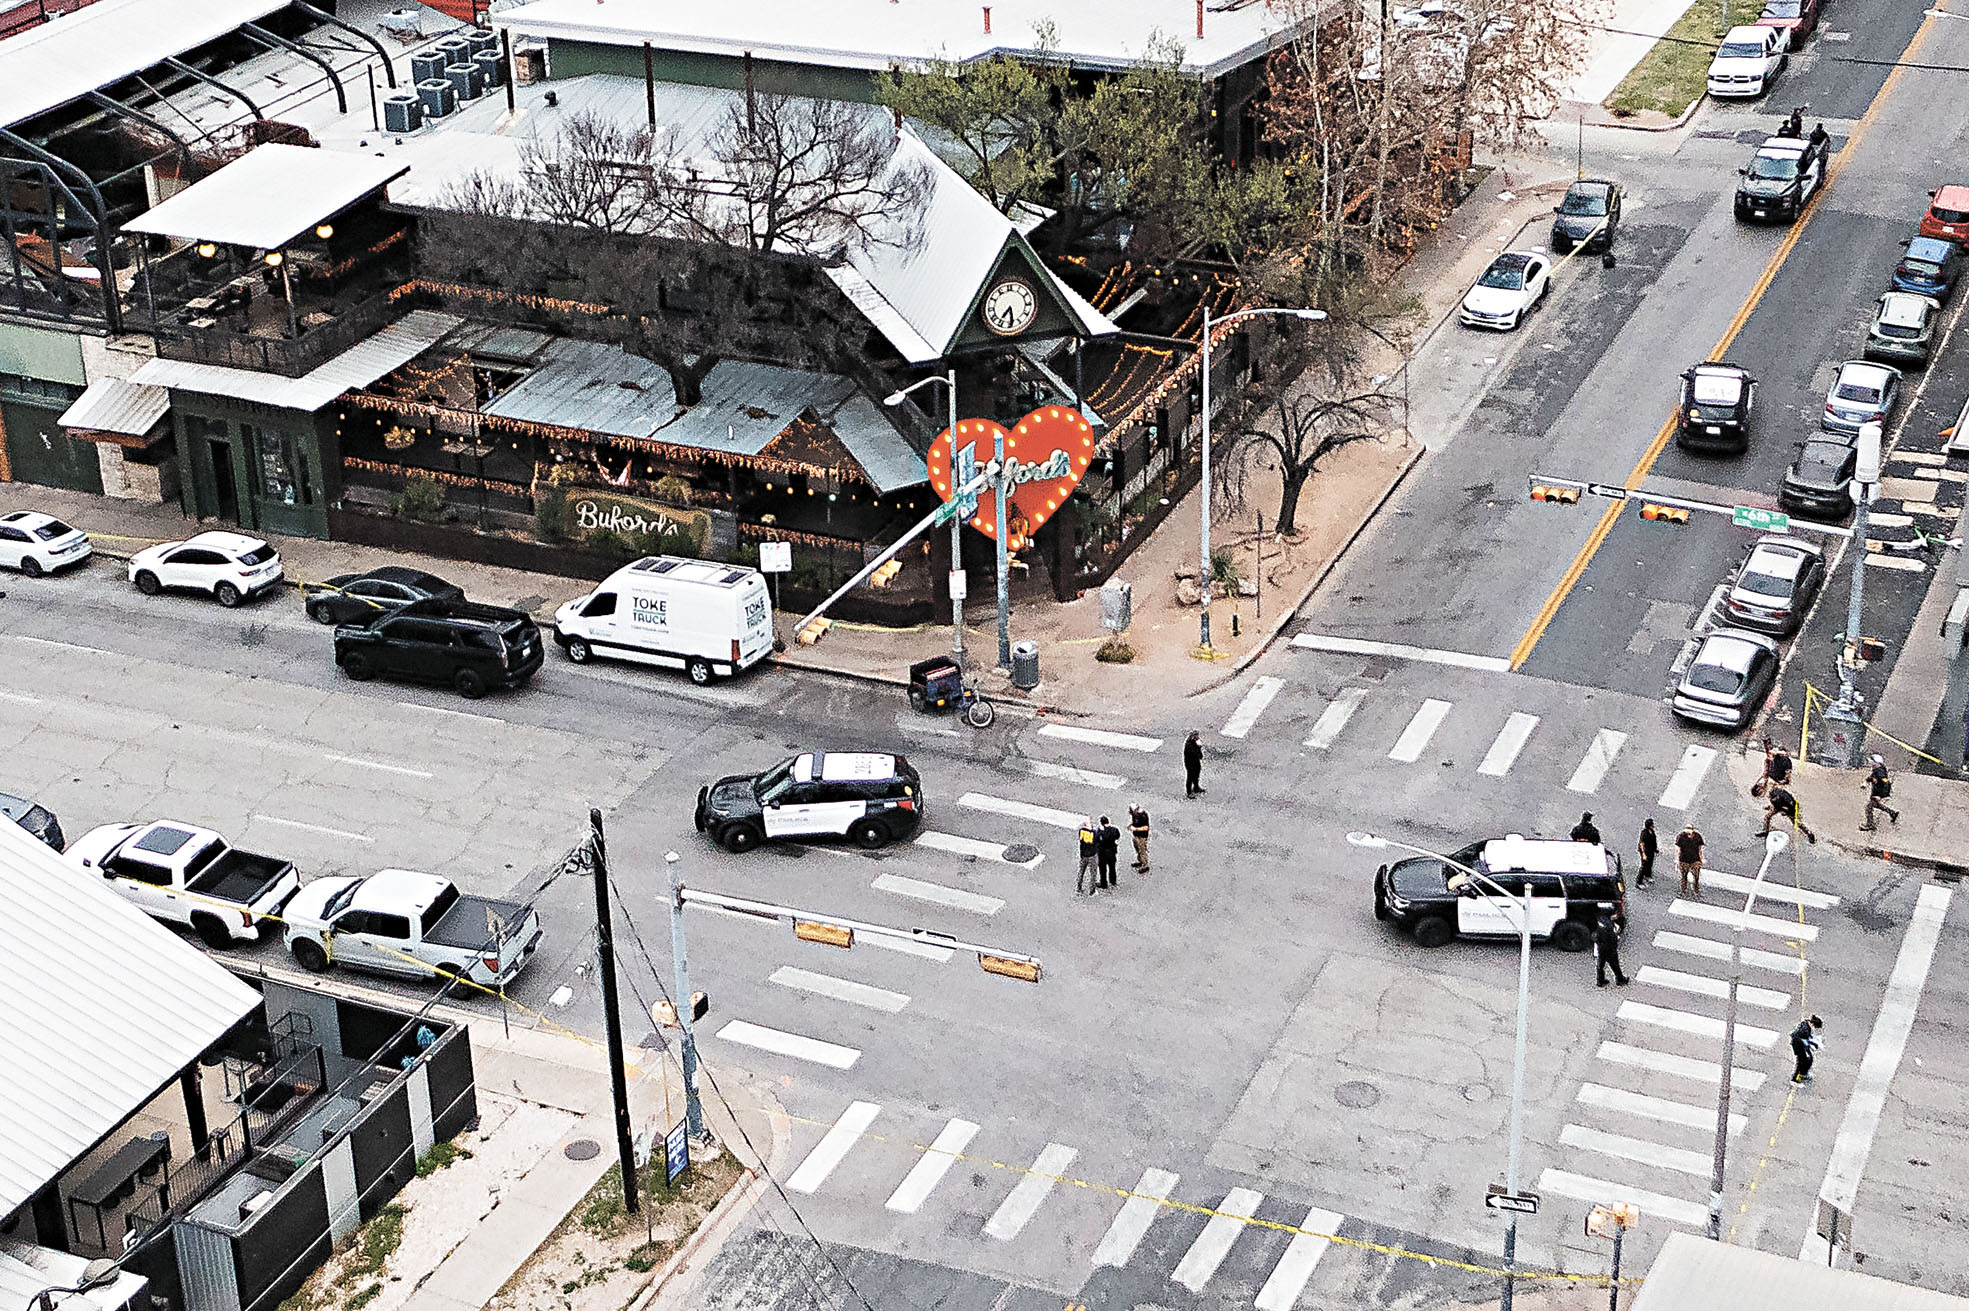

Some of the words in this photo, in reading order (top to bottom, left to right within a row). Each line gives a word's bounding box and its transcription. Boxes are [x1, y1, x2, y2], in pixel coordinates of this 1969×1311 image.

[633, 596, 667, 612] TOKE
[745, 596, 765, 616] TOKE
[633, 612, 667, 626] TRUCK
